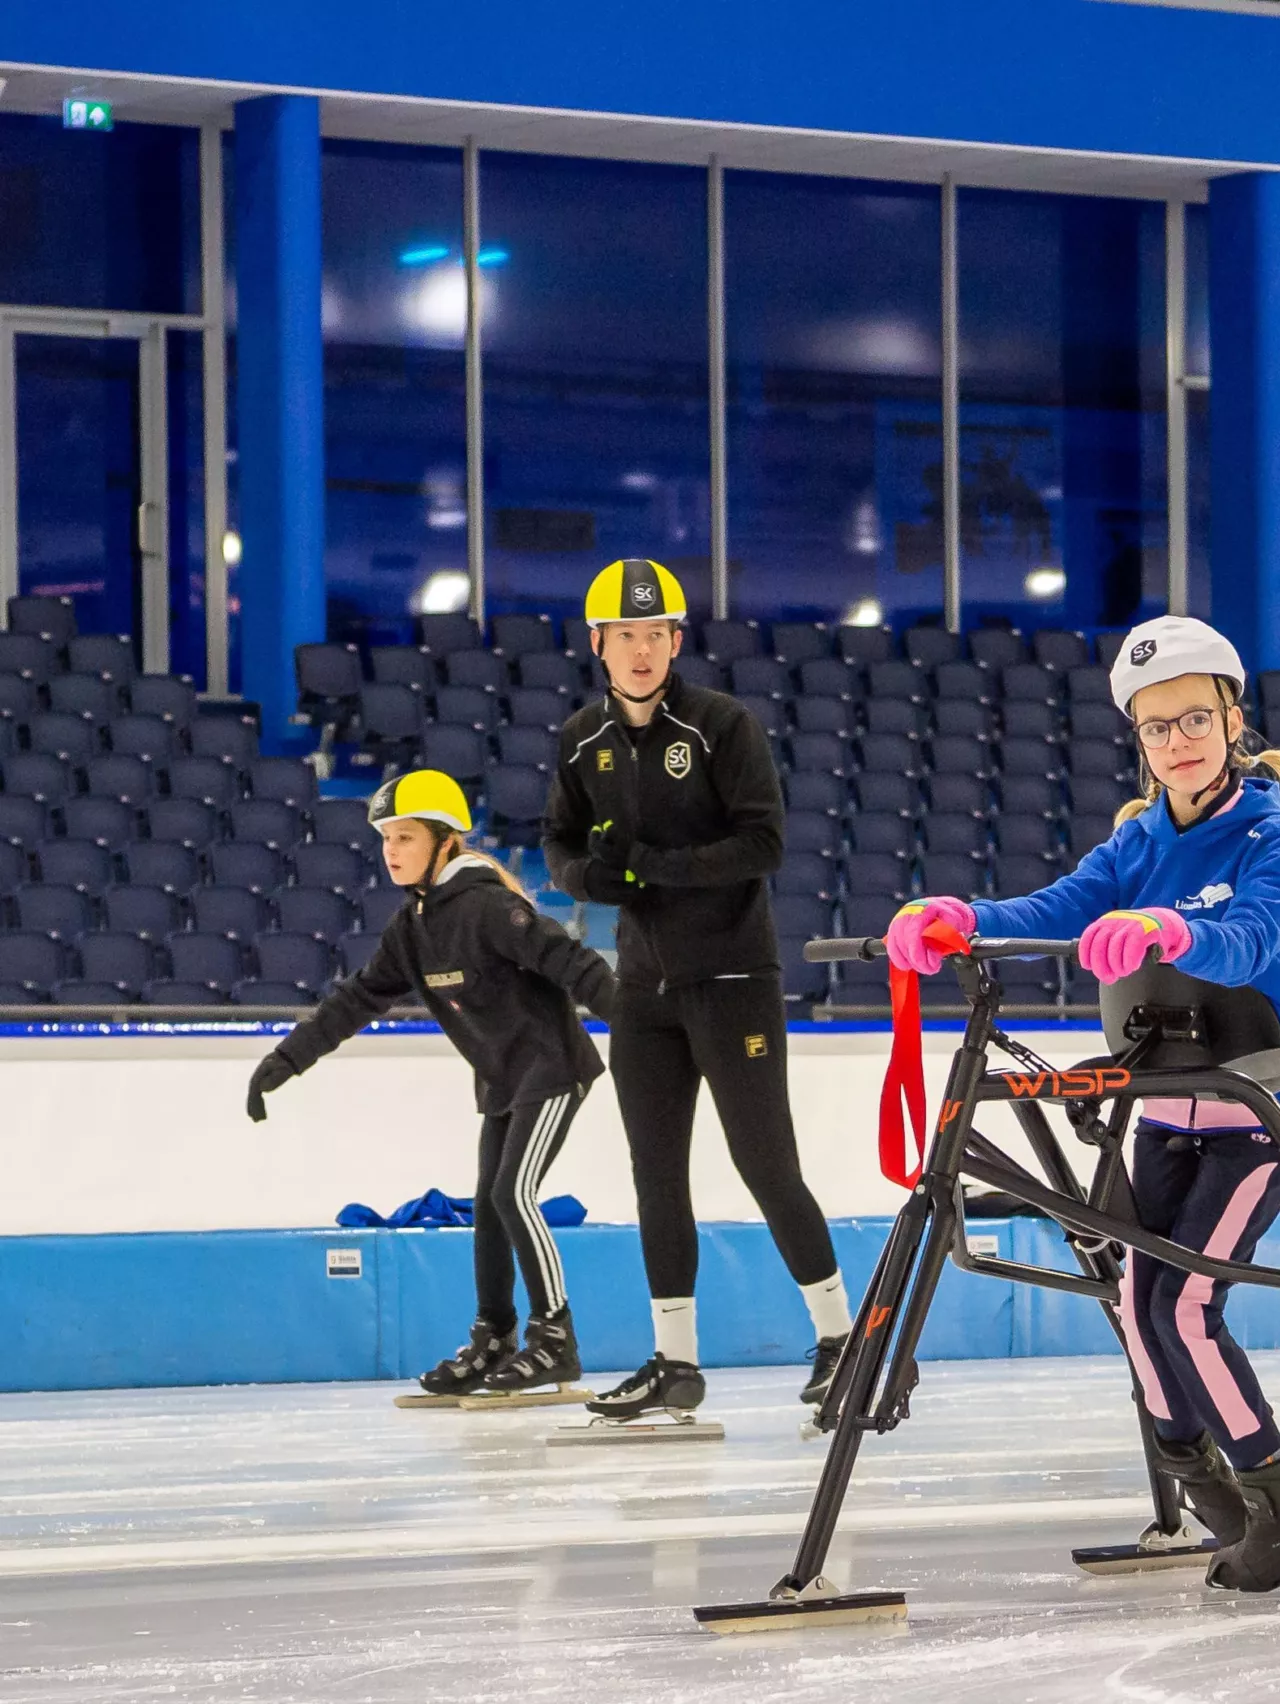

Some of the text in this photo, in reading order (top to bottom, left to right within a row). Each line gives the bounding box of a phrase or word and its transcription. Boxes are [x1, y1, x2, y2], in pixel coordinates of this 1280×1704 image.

[634, 587, 653, 599] SK
[669, 748, 687, 764] SK
[1002, 1068, 1131, 1097] WISP
